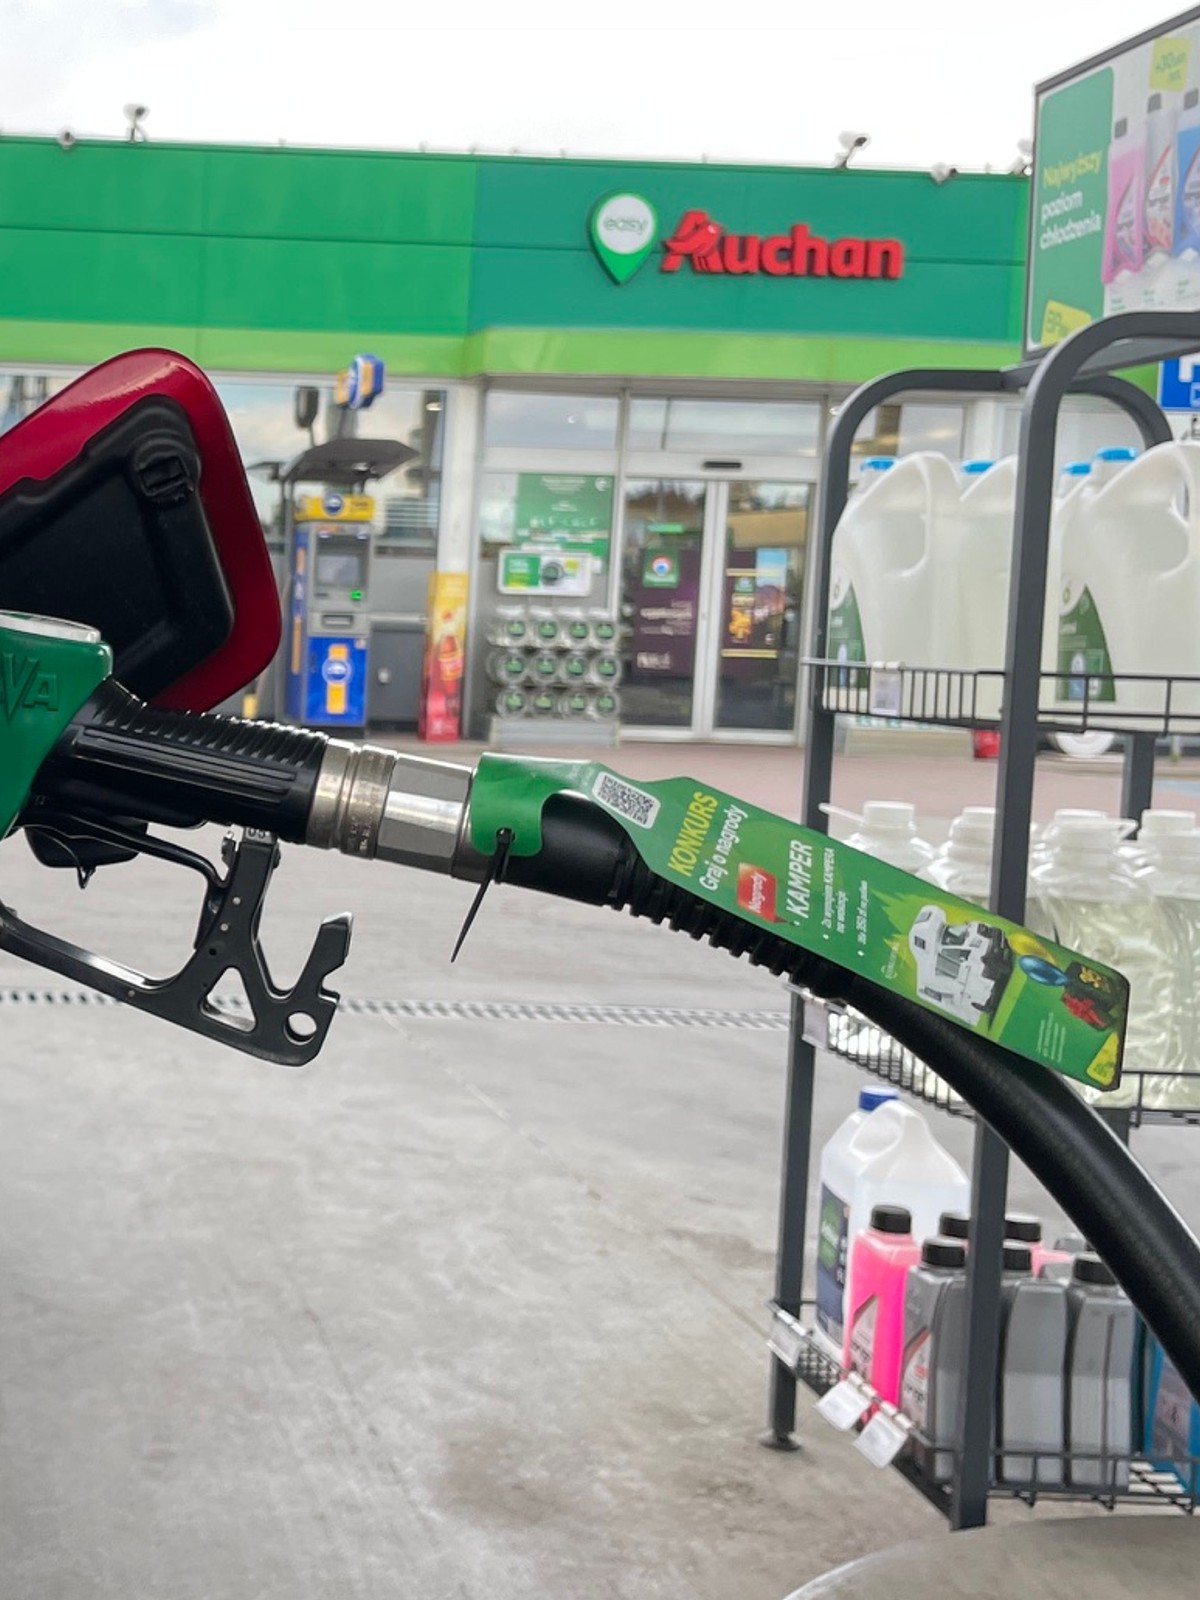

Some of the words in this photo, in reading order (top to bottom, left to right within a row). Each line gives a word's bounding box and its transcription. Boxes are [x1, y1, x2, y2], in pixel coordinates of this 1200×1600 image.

[603, 216, 648, 236] easy
[1041, 190, 1083, 224] poziom
[662, 210, 904, 278] Auchan
[667, 791, 718, 877] KONKURS
[715, 804, 748, 855] nagrody
[699, 859, 728, 891] Graj
[712, 853, 727, 864] o
[786, 840, 812, 919] KAMPER
[748, 872, 767, 914] Nagrody
